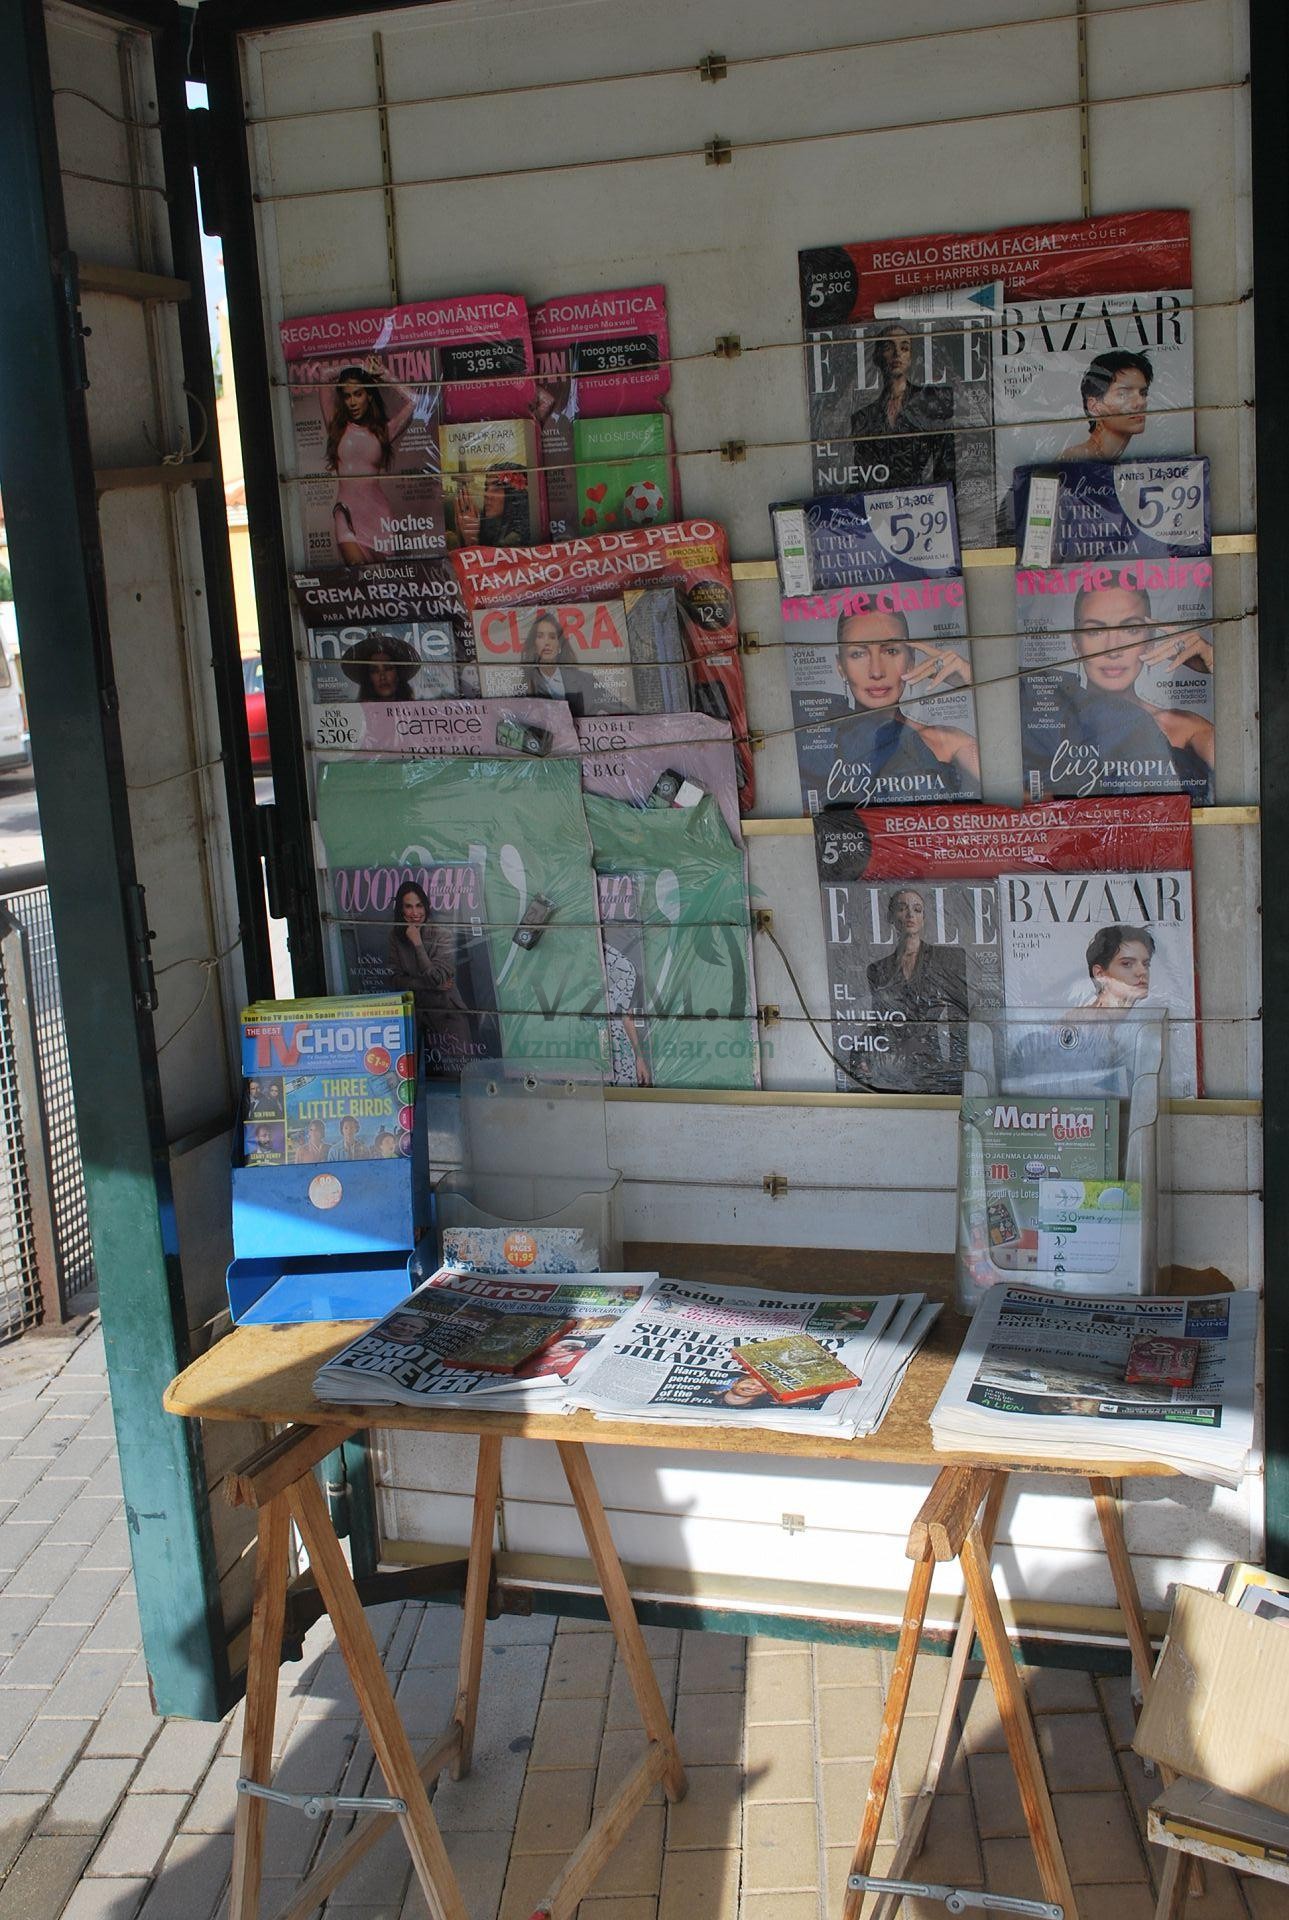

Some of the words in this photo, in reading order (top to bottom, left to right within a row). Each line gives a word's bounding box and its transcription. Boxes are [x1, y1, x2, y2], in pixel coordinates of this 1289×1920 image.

[872, 248, 938, 269] REGALO
[1003, 234, 1061, 254] FACIAL
[1060, 228, 1127, 242] VALQUER
[811, 273, 827, 282] POR
[829, 270, 851, 280] SOLO
[895, 273, 920, 285] ELLE
[935, 264, 988, 280] HARPER'S
[992, 259, 1040, 274] BAZAAR
[550, 296, 657, 322] ROMÁNTICA
[281, 322, 346, 344] REGALO:
[416, 302, 518, 326] ROMÁNTICA
[571, 323, 600, 332] Megan
[601, 318, 636, 328] Maxwell
[582, 348, 605, 357] TODO
[606, 346, 623, 354] POR
[808, 318, 988, 394] ELLE
[1000, 296, 1186, 356] BAZAAR
[452, 350, 476, 360] TODO
[476, 348, 491, 356] POR
[630, 374, 660, 384] ELEGIR
[1019, 373, 1033, 384] del
[491, 428, 514, 438] PARA
[484, 442, 506, 453] FLOR
[816, 443, 839, 458] EL
[818, 464, 890, 486] NUEVO
[1119, 472, 1144, 481] ANTES
[870, 501, 894, 511] ANTES
[380, 514, 434, 533] Noches
[1062, 522, 1132, 538] ILUMINA
[310, 539, 332, 550] 2023
[373, 532, 446, 552] brillantes
[598, 532, 639, 552] DE
[644, 522, 715, 546] PELO
[1073, 540, 1140, 556] MIRADA
[820, 549, 888, 568] ILUMINA
[467, 562, 564, 592] TAMAÑO
[570, 550, 664, 578] GRANDE
[834, 566, 896, 584] MIRADA
[1016, 560, 1113, 596] marie
[1118, 558, 1212, 592] claire
[305, 587, 366, 606] CREMA
[474, 593, 512, 606] Alisado
[526, 586, 577, 600] Ondulado
[634, 574, 688, 586] duraderos
[780, 586, 870, 622] marie
[877, 578, 966, 614] claire
[322, 614, 344, 622] PARA
[346, 601, 408, 620] MANOS
[410, 600, 422, 615] Y
[933, 624, 960, 632] BELLEZA
[800, 656, 826, 664] RELOJES
[1156, 680, 1172, 688] ORO
[1175, 680, 1206, 688] BLANCO
[919, 697, 936, 706] ORO
[937, 695, 967, 705] BLANCO
[324, 709, 342, 718] POR
[386, 706, 438, 718] REGALO
[444, 704, 488, 716] DOBLE
[320, 718, 348, 728] SOLO
[588, 720, 636, 733] DOBLE
[316, 729, 358, 744] 5,50€
[1068, 744, 1100, 758] CON
[594, 762, 626, 778] BAG
[842, 761, 872, 777] CON
[1050, 740, 1105, 798] luz
[1102, 760, 1177, 776] PROPIA
[827, 758, 878, 808] luz
[876, 773, 946, 794] PROPIA
[1100, 780, 1142, 788] Tendencias
[1144, 779, 1163, 788] para
[1164, 778, 1207, 787] deslumbrar
[914, 794, 934, 802] para
[886, 816, 949, 832] REGALO
[1012, 810, 1066, 827] FACIAL
[825, 833, 841, 841] POR
[842, 832, 864, 840] SOLO
[908, 838, 932, 848] ELLE
[947, 834, 999, 846] HARPER'S
[1001, 832, 1048, 844] BAZAAR
[934, 848, 980, 860] REGALO
[984, 847, 1034, 858] VALQUER
[824, 887, 998, 946] ELLE
[1008, 877, 1186, 924] BAZAAR
[1026, 939, 1040, 949] del
[1012, 950, 1030, 961] lujo
[834, 984, 856, 1000] EL
[315, 1012, 336, 1020] Spain
[836, 1010, 906, 1027] NUEVO
[246, 1027, 260, 1036] THE
[262, 1026, 281, 1036] BEST
[247, 1022, 308, 1068] TV
[296, 1025, 400, 1054] CHOICE
[838, 1034, 890, 1052] CHIC
[322, 1078, 368, 1097] THREE
[299, 1100, 344, 1120] LITTLE
[350, 1098, 392, 1118] BIRDS
[994, 1105, 1094, 1130] Marina
[1053, 1124, 1092, 1140] Guía
[1021, 1188, 1040, 1199] Lotes
[508, 1252, 534, 1262] €1.95
[441, 1276, 550, 1301] Mirror
[658, 1282, 724, 1306] Daily
[758, 1298, 817, 1310] Mail
[530, 1302, 577, 1314] thousands
[1006, 1290, 1054, 1305] Costa
[1063, 1298, 1126, 1312] Blanca
[1135, 1302, 1183, 1314] News
[997, 1321, 1118, 1337] PRICE-FIXING
[999, 1314, 1070, 1327] ENERGY
[1076, 1320, 1134, 1332] GIANT
[631, 1334, 674, 1348] AT
[990, 1344, 1032, 1354] Freeing
[1036, 1346, 1050, 1354] the
[1056, 1348, 1074, 1357] fab
[1078, 1350, 1100, 1360] four
[333, 1351, 478, 1393] FOREVER
[674, 1366, 707, 1380] Harry,
[710, 1370, 729, 1379] the
[664, 1384, 701, 1392] prince
[668, 1375, 732, 1388] petrolhead
[655, 1396, 688, 1404] Grand
[692, 1396, 715, 1404] Prix
[660, 1390, 674, 1398] of
[675, 1390, 693, 1398] the
[996, 1402, 1025, 1412] LION
